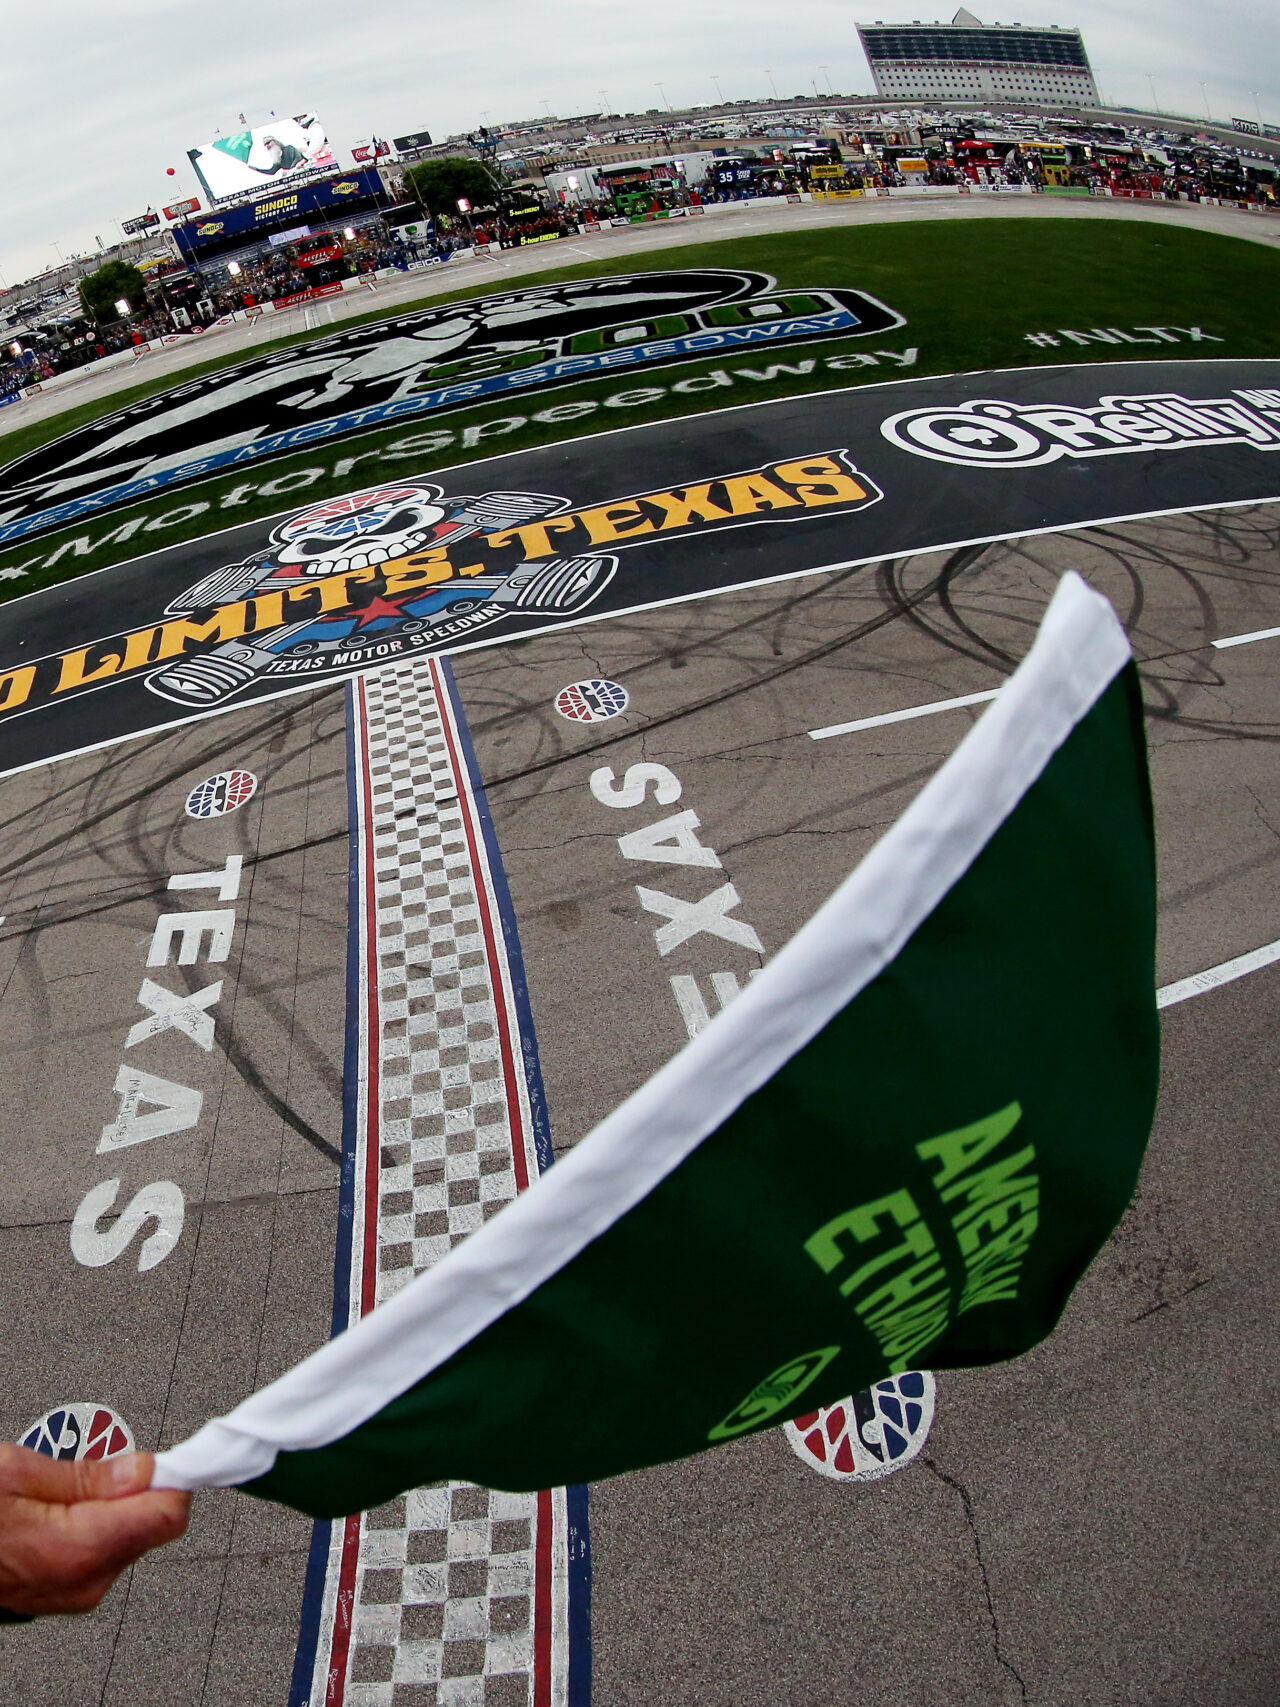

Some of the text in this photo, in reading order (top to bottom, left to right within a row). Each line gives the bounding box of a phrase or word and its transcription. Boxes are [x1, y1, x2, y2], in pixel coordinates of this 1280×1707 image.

[217, 166, 329, 203] TEXAS MOTOR SPEEDWAY
[333, 182, 359, 195] SUNOCO
[718, 171, 733, 183] 35
[253, 194, 299, 215] SUNOCO
[254, 204, 298, 221] VICTORY LANE
[197, 222, 223, 235] SUNOCO
[521, 232, 560, 245] 5-hour ENERGY
[408, 256, 442, 271] GEICO
[267, 279, 633, 363] COMMANDER
[1024, 327, 1225, 348] #NLTX
[0, 315, 844, 539] TEXAS MOTOR SPEEDWAY
[906, 398, 1274, 460] O'Reilly
[484, 455, 867, 560] TEXAS
[266, 602, 506, 674] TEXAS MOTOR SPEEDWAY
[589, 760, 767, 1040] EXAS
[70, 854, 243, 1272] TEXAS
[915, 1101, 1039, 1317] AMERAN
